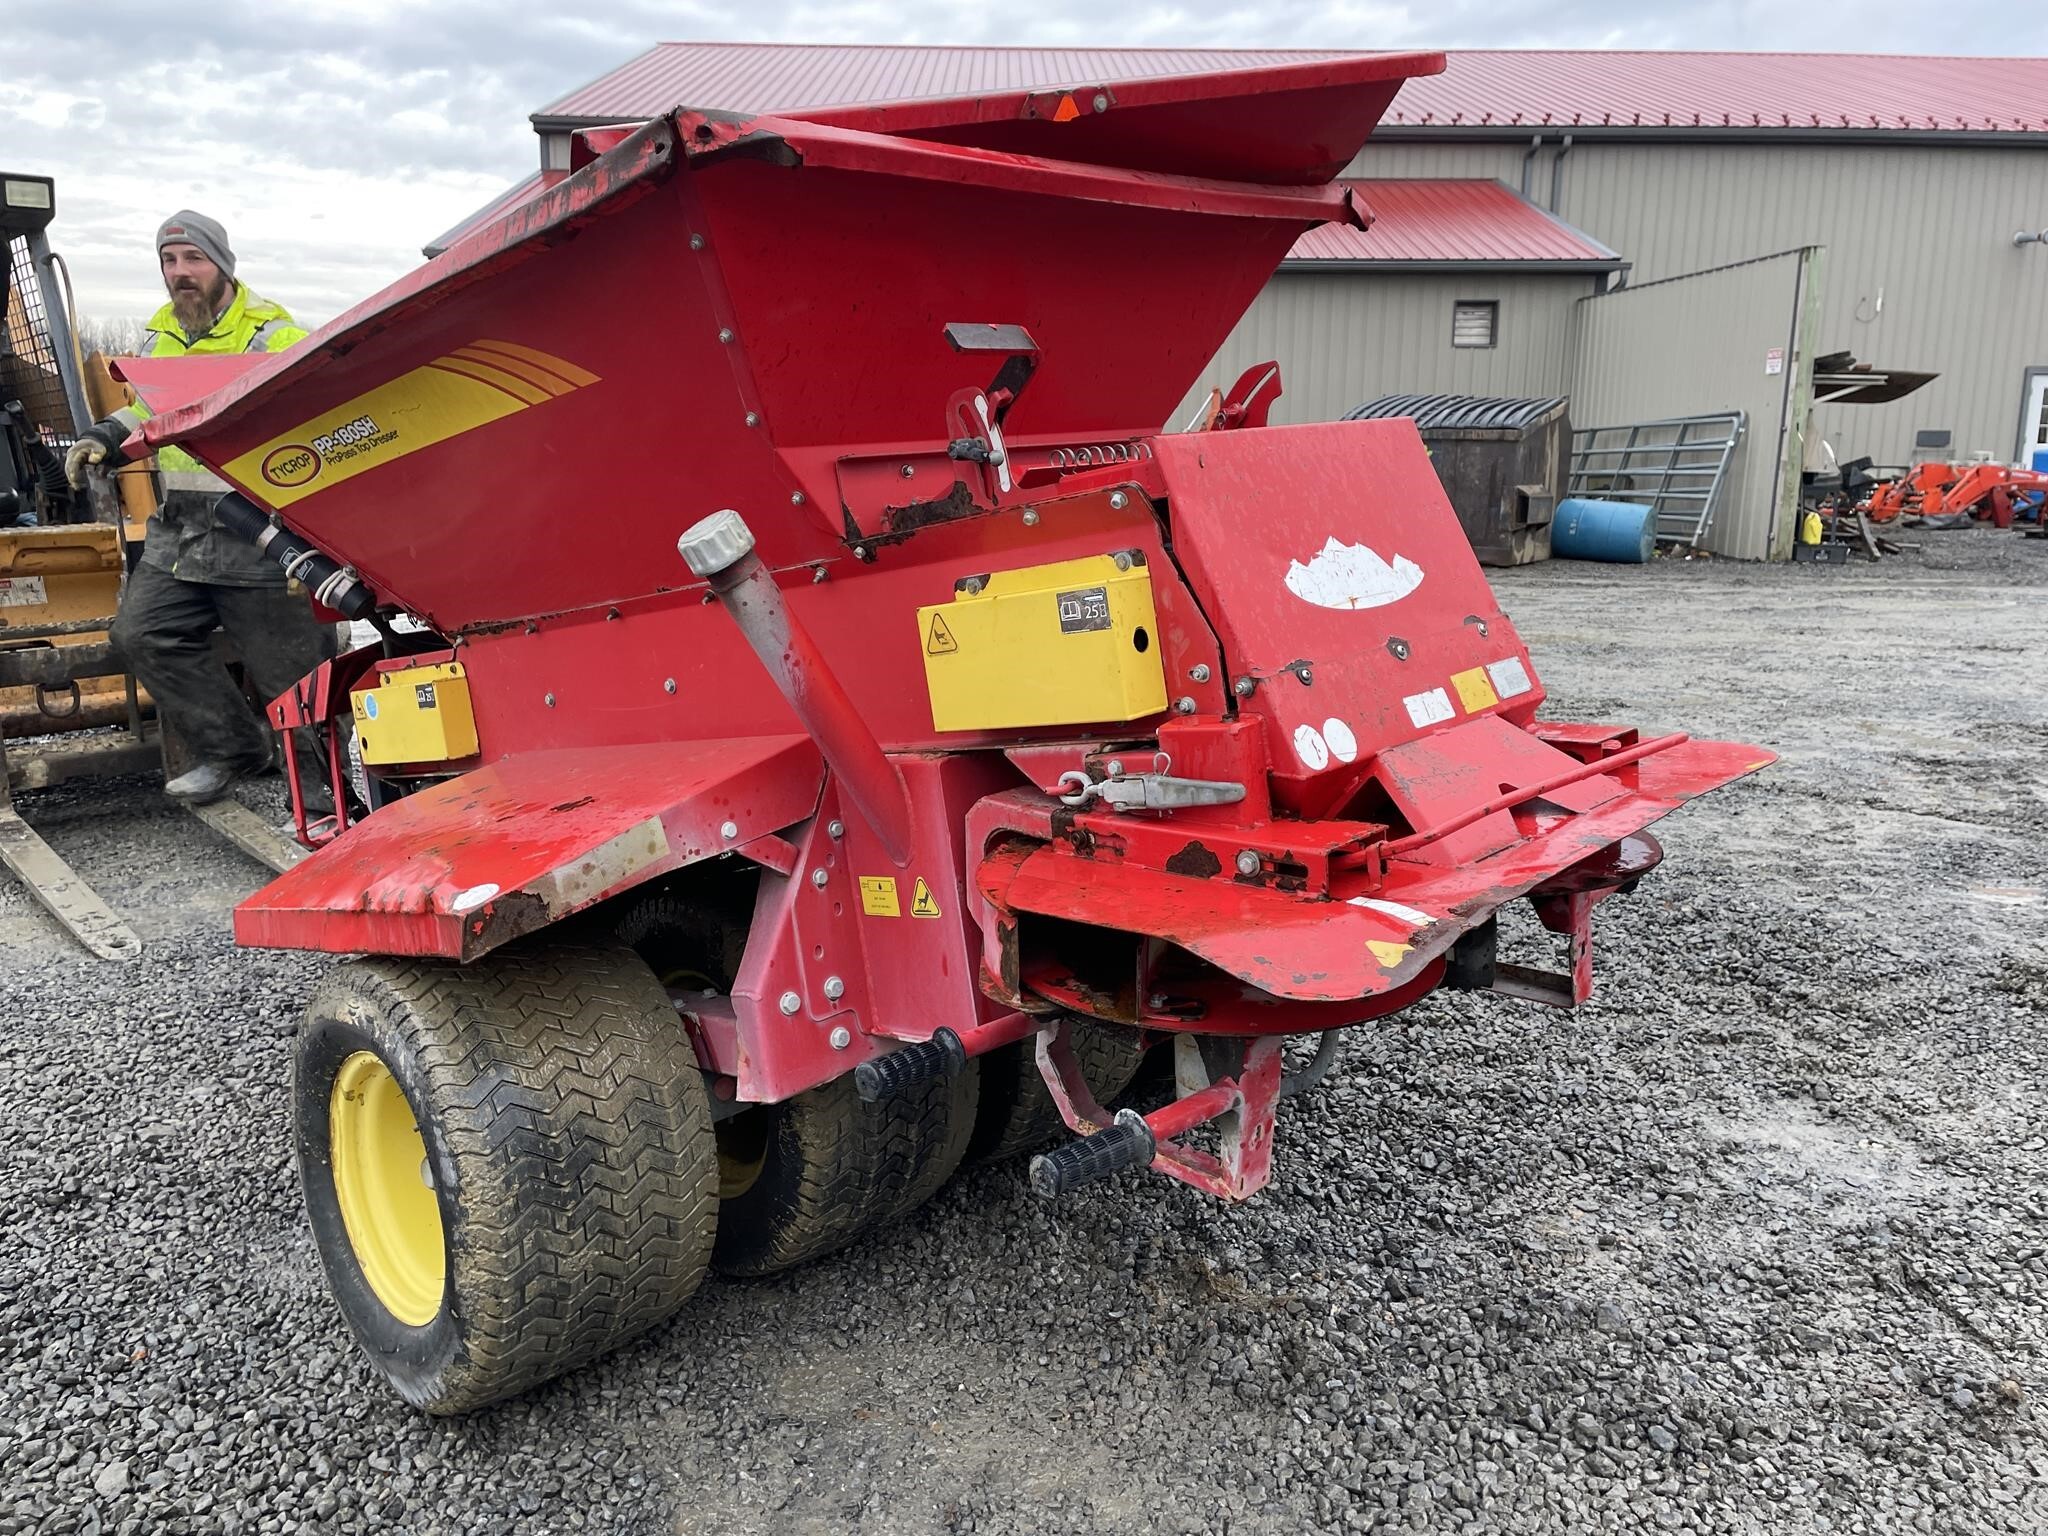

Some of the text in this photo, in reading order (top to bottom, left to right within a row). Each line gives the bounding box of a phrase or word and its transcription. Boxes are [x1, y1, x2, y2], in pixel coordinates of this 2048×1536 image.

[311, 415, 380, 456] PP-180SH
[325, 430, 399, 466] ProPass Top Dresser
[270, 453, 311, 479] TYCROP
